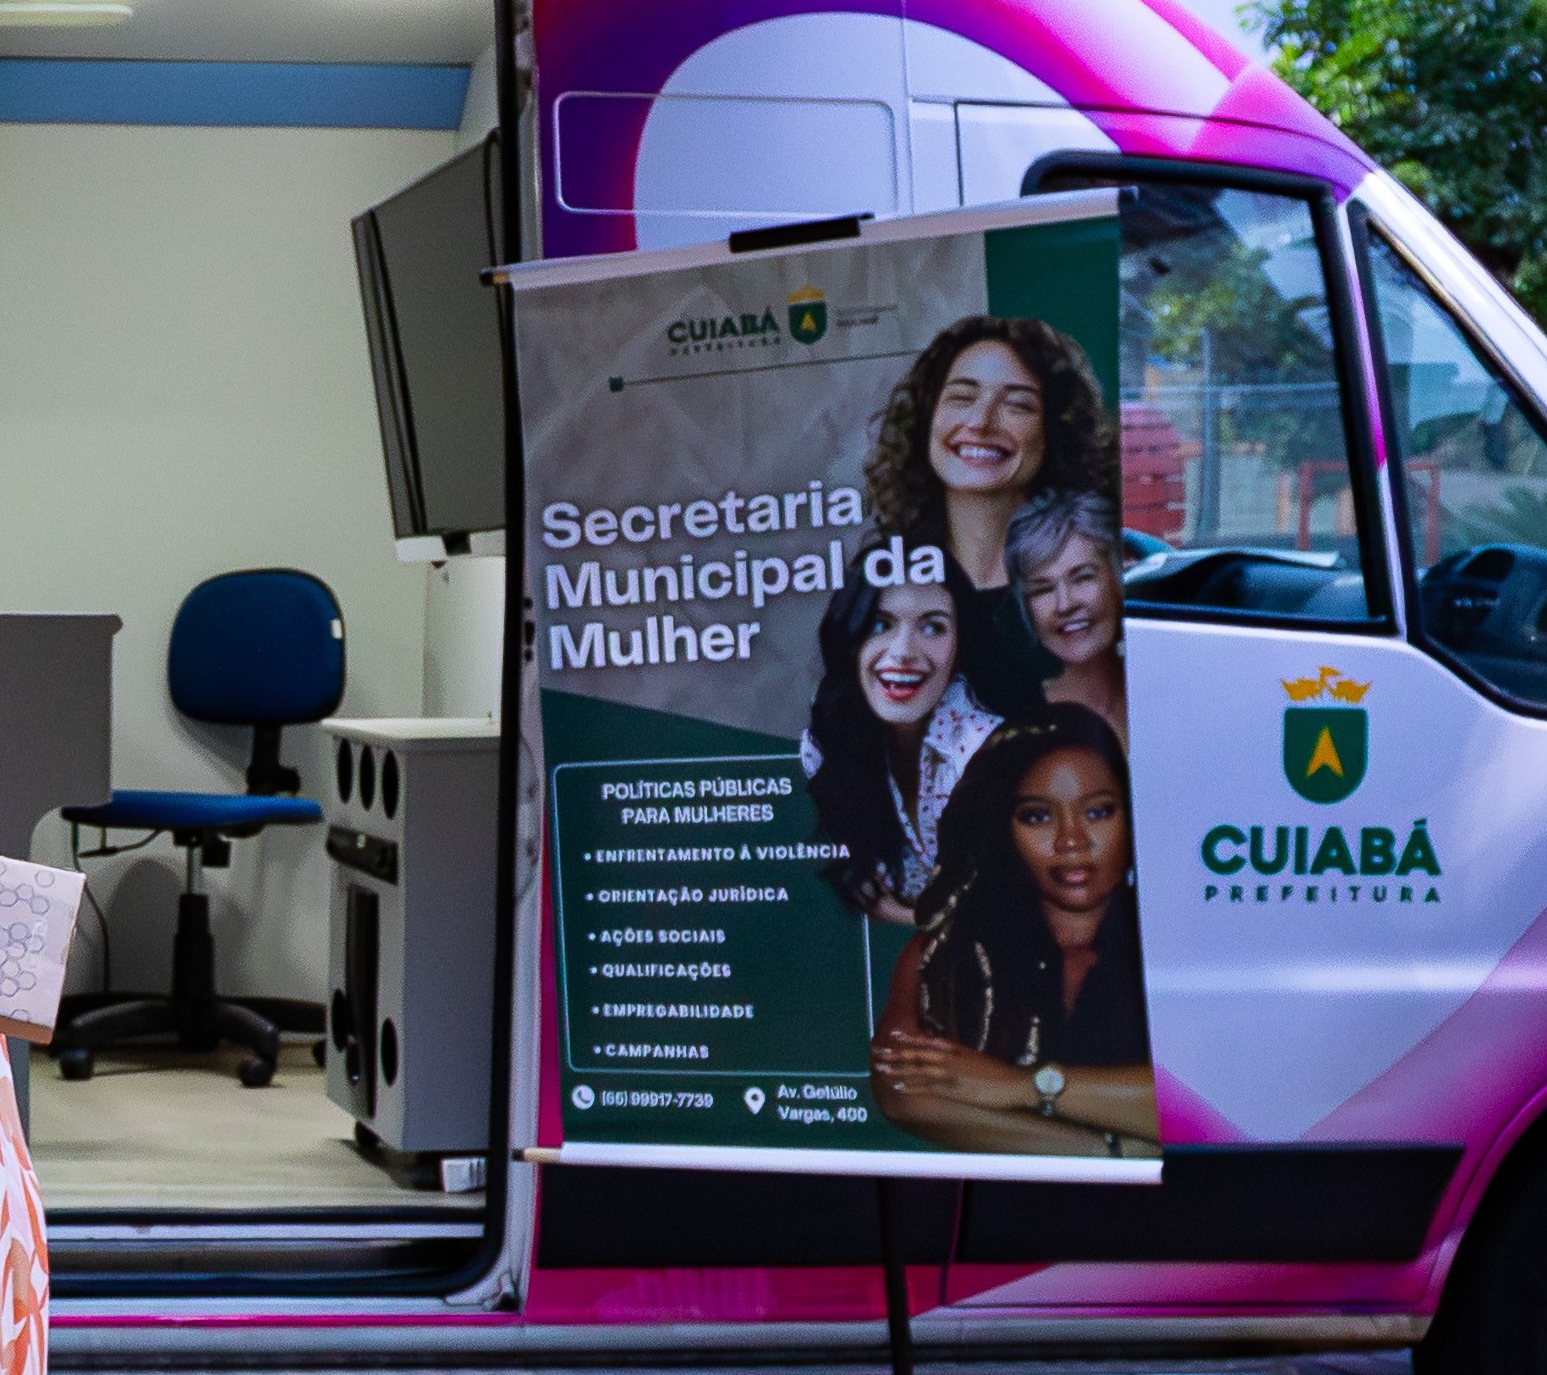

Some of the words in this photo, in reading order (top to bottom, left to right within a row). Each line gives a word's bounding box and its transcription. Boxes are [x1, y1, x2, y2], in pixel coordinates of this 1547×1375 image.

[667, 306, 780, 343] CUIABÁ
[542, 480, 863, 549] Secretaria
[546, 540, 844, 609] Municipal
[864, 535, 945, 586] da
[549, 615, 761, 671] Mulher
[601, 780, 696, 799] POLÍTICAS
[699, 777, 792, 797] PÚBLICAS
[622, 807, 670, 824] PARA
[674, 804, 774, 823] MULHERES
[596, 847, 735, 863] ENFRENTAMENTO
[756, 842, 850, 860] VIOLÊNCIA
[1201, 817, 1442, 877] CUIABÁ
[598, 886, 703, 906] ORIENTAÇÃO
[708, 886, 789, 902] JURÍDICA
[1204, 885, 1441, 904] PREFEITURA
[600, 928, 653, 947] AÇÕES
[659, 929, 725, 944] SOCIAIS
[602, 962, 731, 981] QUALIFICAÇÕES
[605, 1044, 709, 1059] CAMPANHAS
